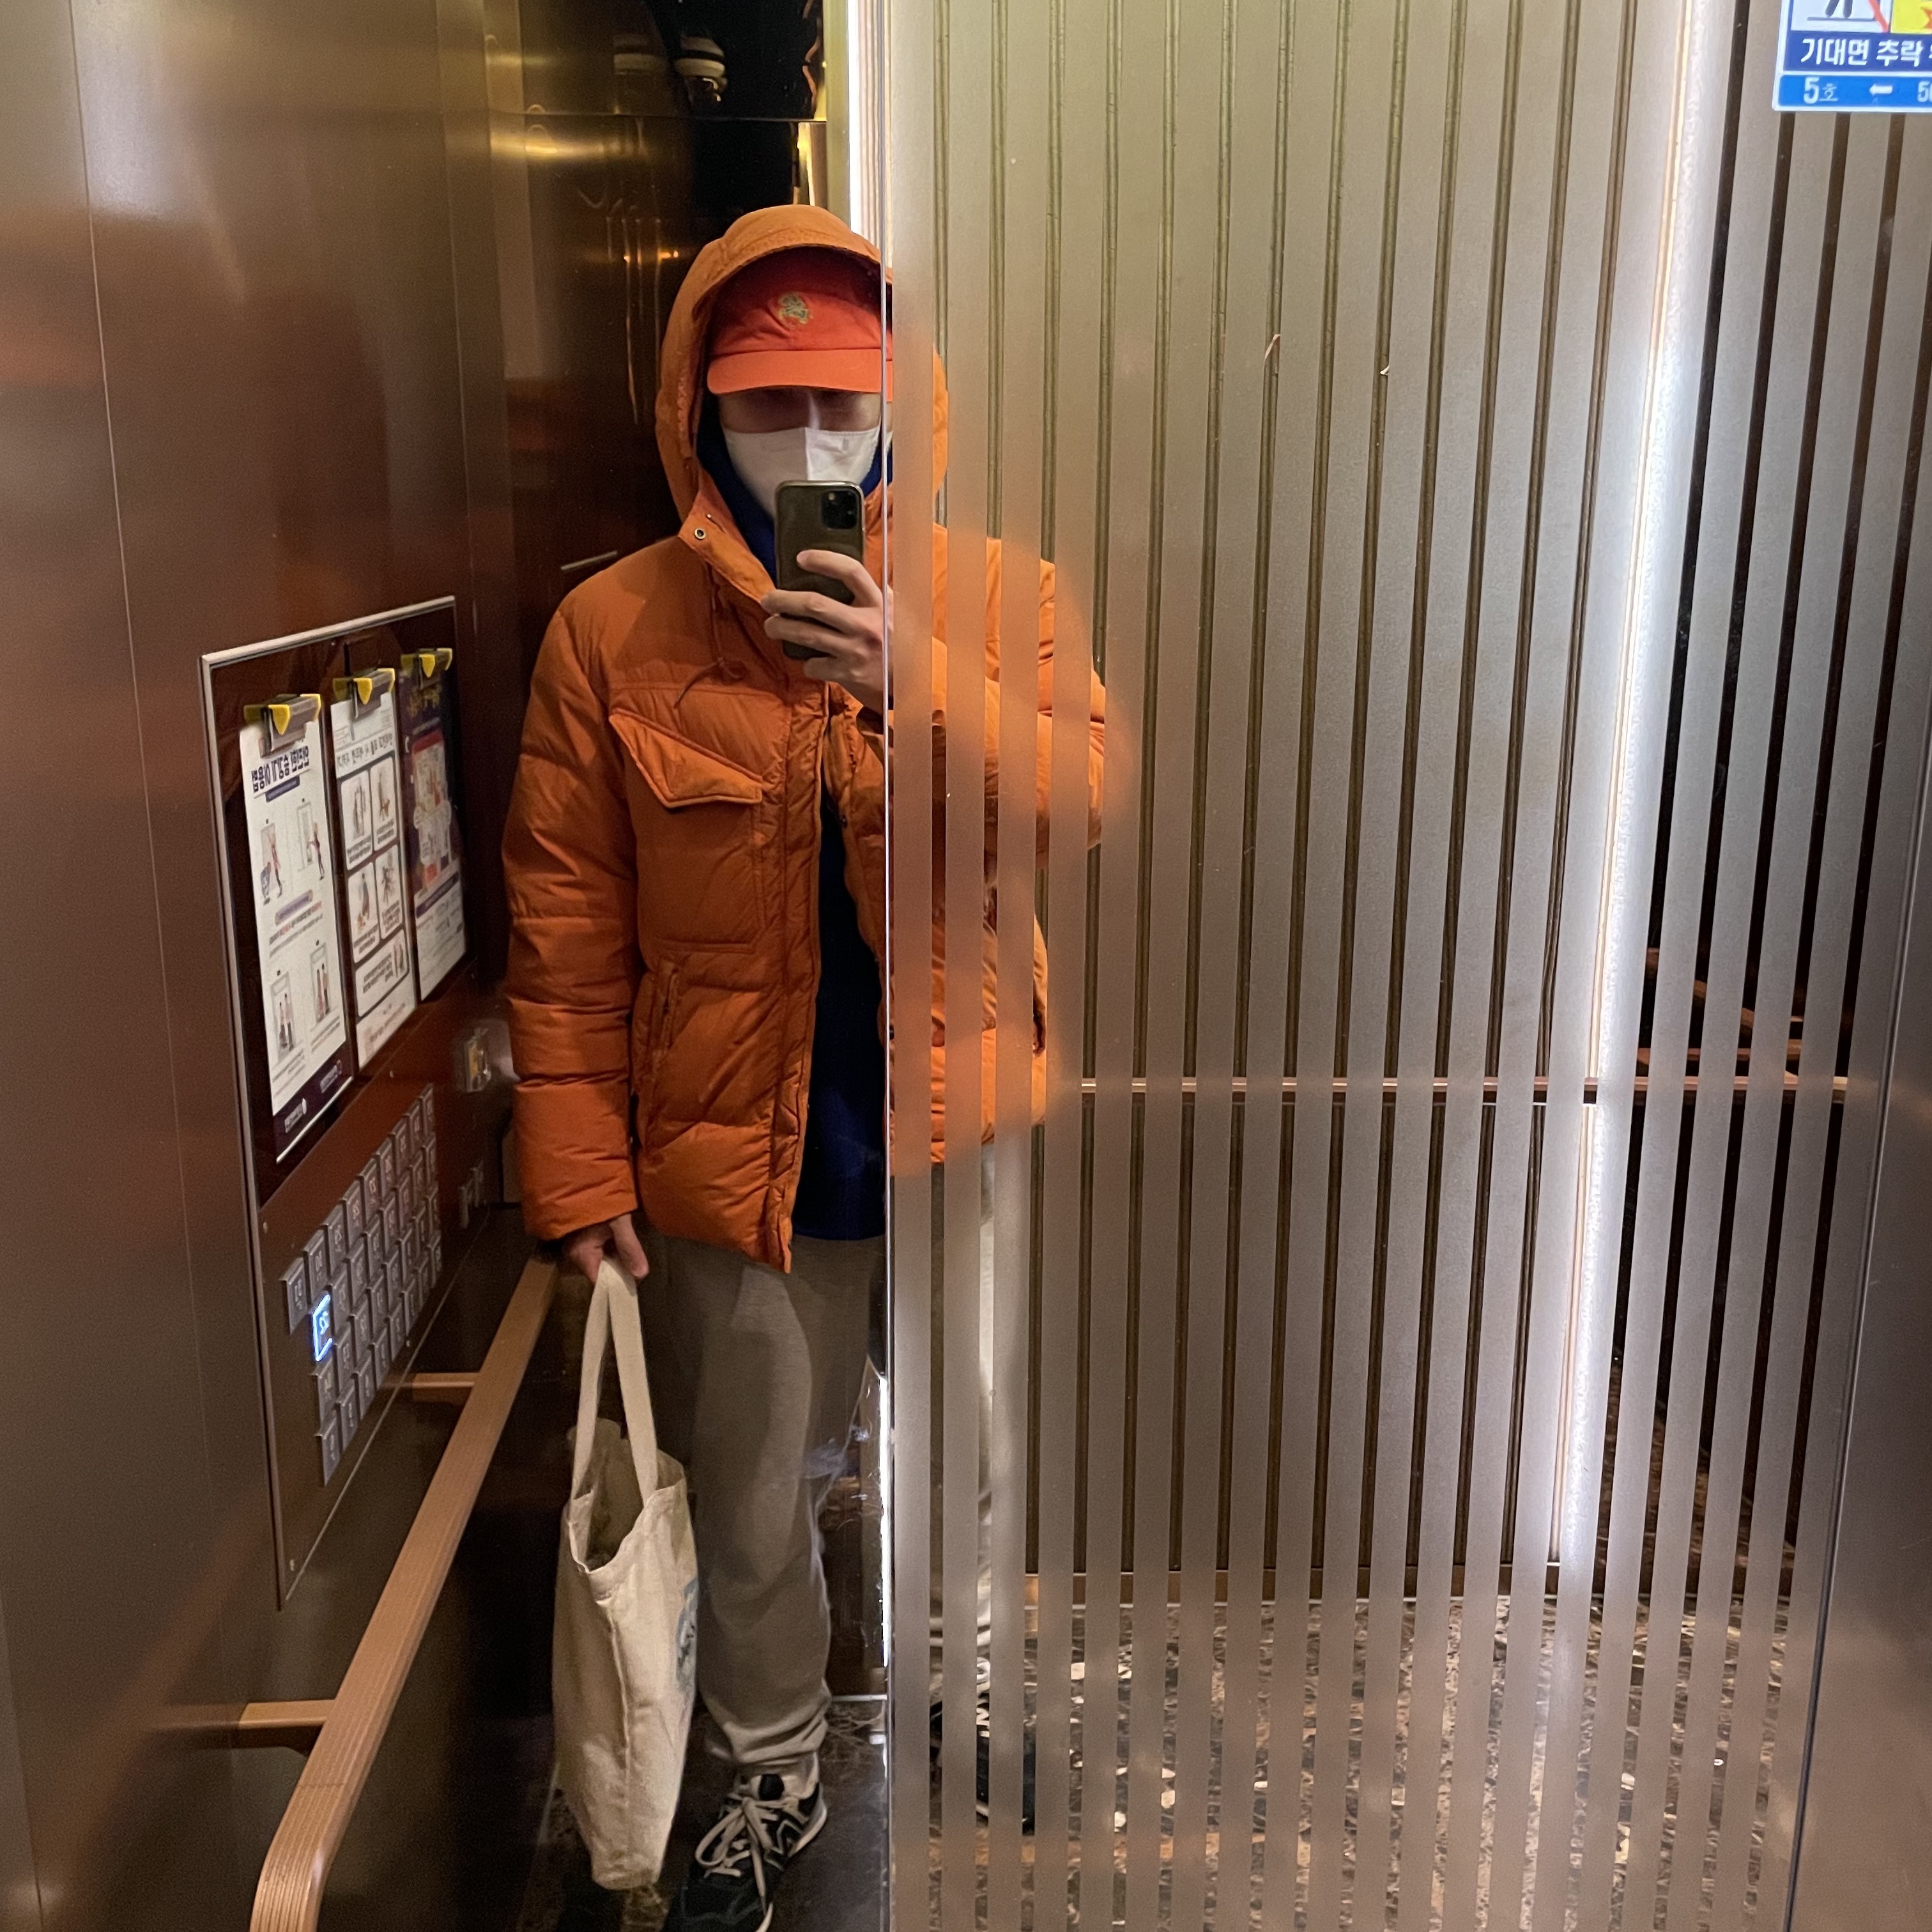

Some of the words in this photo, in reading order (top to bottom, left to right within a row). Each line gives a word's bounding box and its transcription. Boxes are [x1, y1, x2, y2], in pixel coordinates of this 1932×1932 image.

[1800, 38, 1869, 66] 기대면
[1876, 39, 1924, 67] 추락
[1803, 76, 1839, 104] 5호
